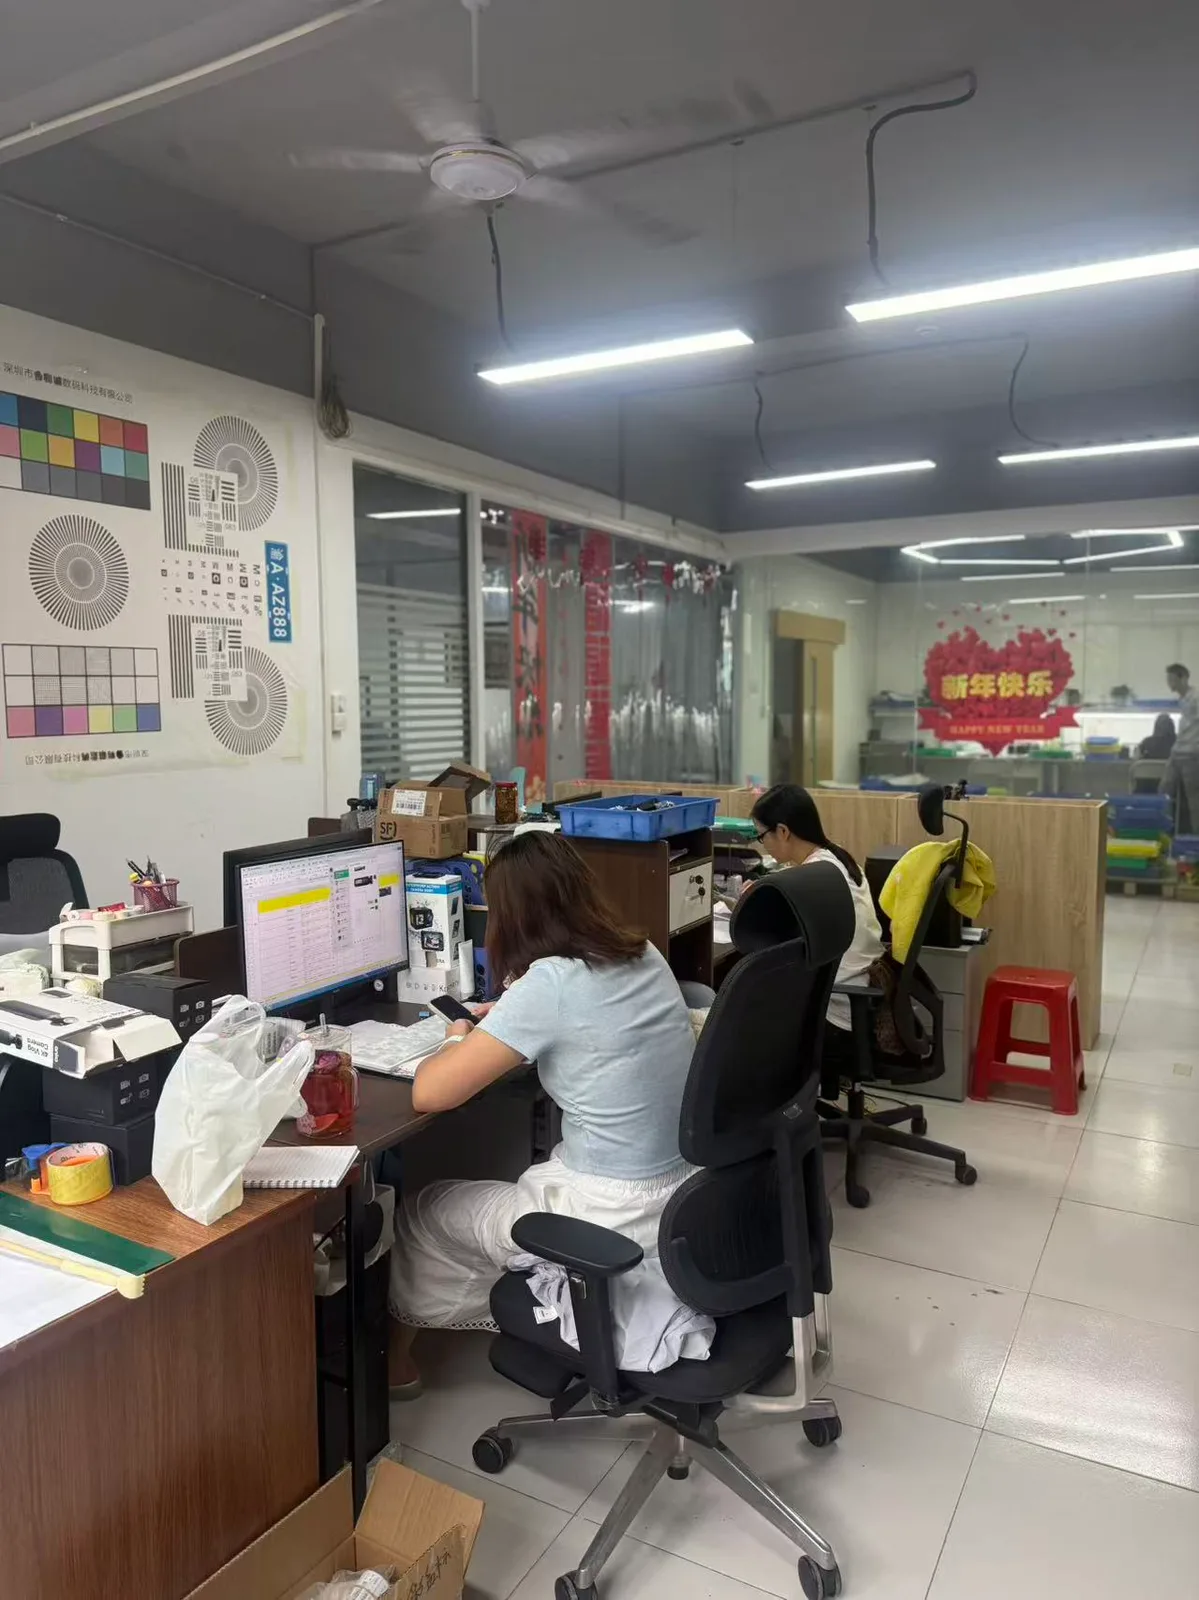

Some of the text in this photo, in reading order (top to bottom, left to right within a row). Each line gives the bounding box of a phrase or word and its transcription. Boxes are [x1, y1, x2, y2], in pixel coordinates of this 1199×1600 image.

[941, 670, 1054, 700] 新年快乐
[949, 724, 1044, 734] HAPPY NEW YEAR
[27, 1038, 48, 1050] Camera
[27, 1044, 48, 1058] 4K Vlog
